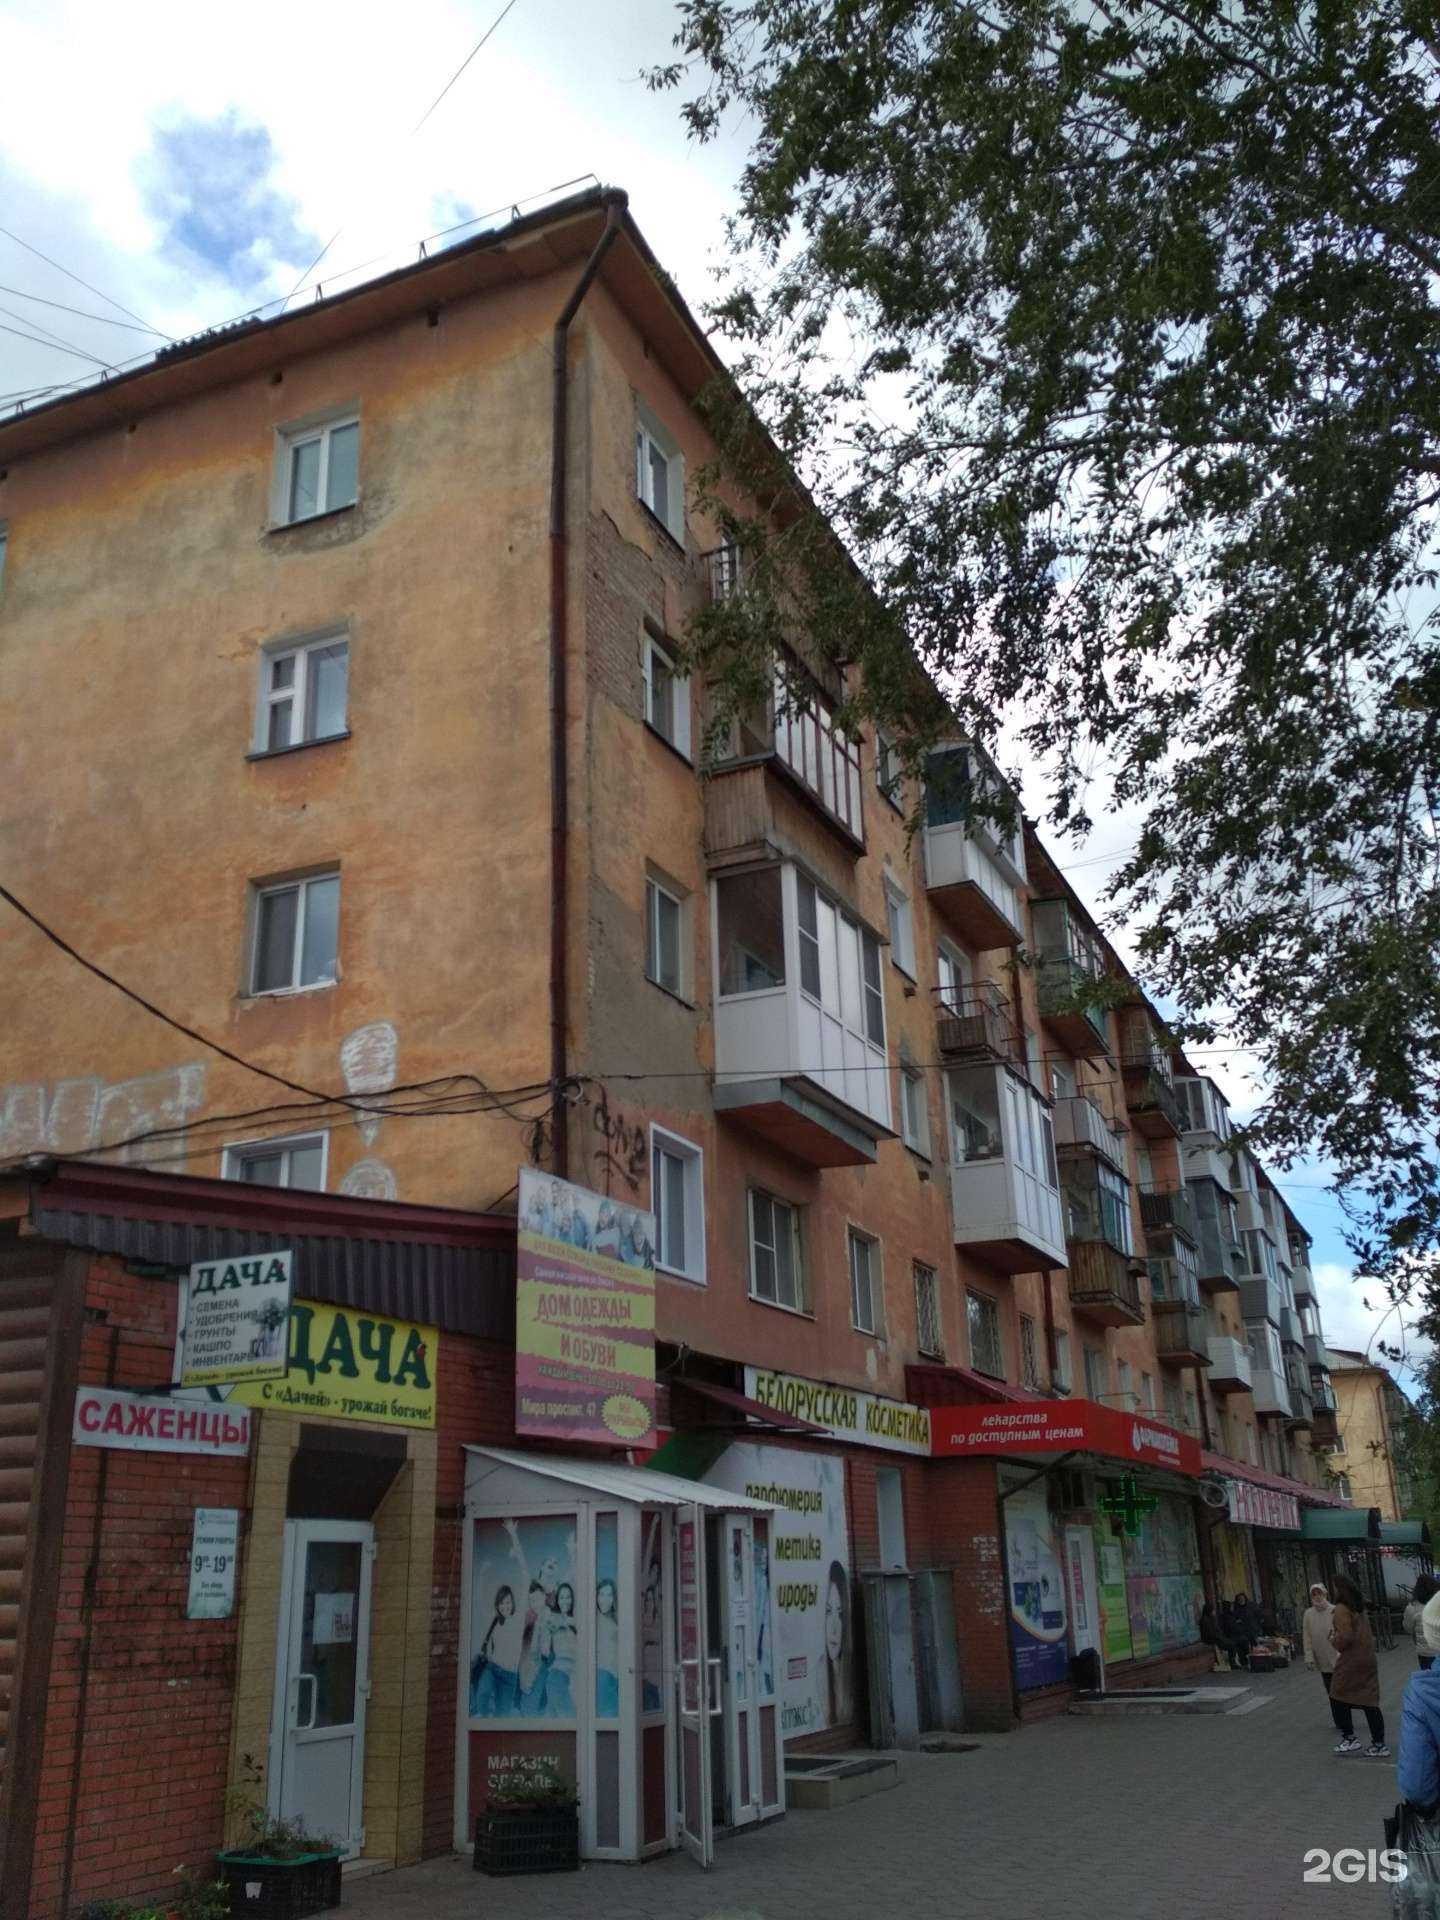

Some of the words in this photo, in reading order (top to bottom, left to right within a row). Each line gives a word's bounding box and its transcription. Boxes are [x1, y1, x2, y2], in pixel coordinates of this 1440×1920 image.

[193, 1259, 287, 1297] ДАЧА
[196, 1299, 239, 1313] СЕМЕНА
[537, 1293, 570, 1321] ДОМ
[574, 1295, 632, 1326] ОДЕЖДЫ
[193, 1340, 232, 1353] КАШПО
[194, 1326, 236, 1339] ГРУНТЫ
[287, 1305, 431, 1390] ДАЧА
[560, 1334, 571, 1357] И
[574, 1338, 617, 1368] ОБУВИ
[262, 1383, 272, 1400] С
[341, 1398, 388, 1416] урожай
[391, 1398, 432, 1420] богаче!
[756, 1375, 857, 1428] БЕЛОРУССКАЯ
[79, 1399, 248, 1448] САЖЕНЦЫ
[865, 1401, 929, 1444] КОСМЕТИКА
[950, 1432, 966, 1445] по
[967, 1429, 1041, 1445] доступным
[1045, 1426, 1084, 1441] ценам
[981, 1412, 1048, 1428] лекарства
[745, 1481, 823, 1513] парфюмерия
[775, 1533, 821, 1560] метика
[778, 1582, 818, 1613] ироды
[488, 1755, 560, 1770] МАГАЗИН
